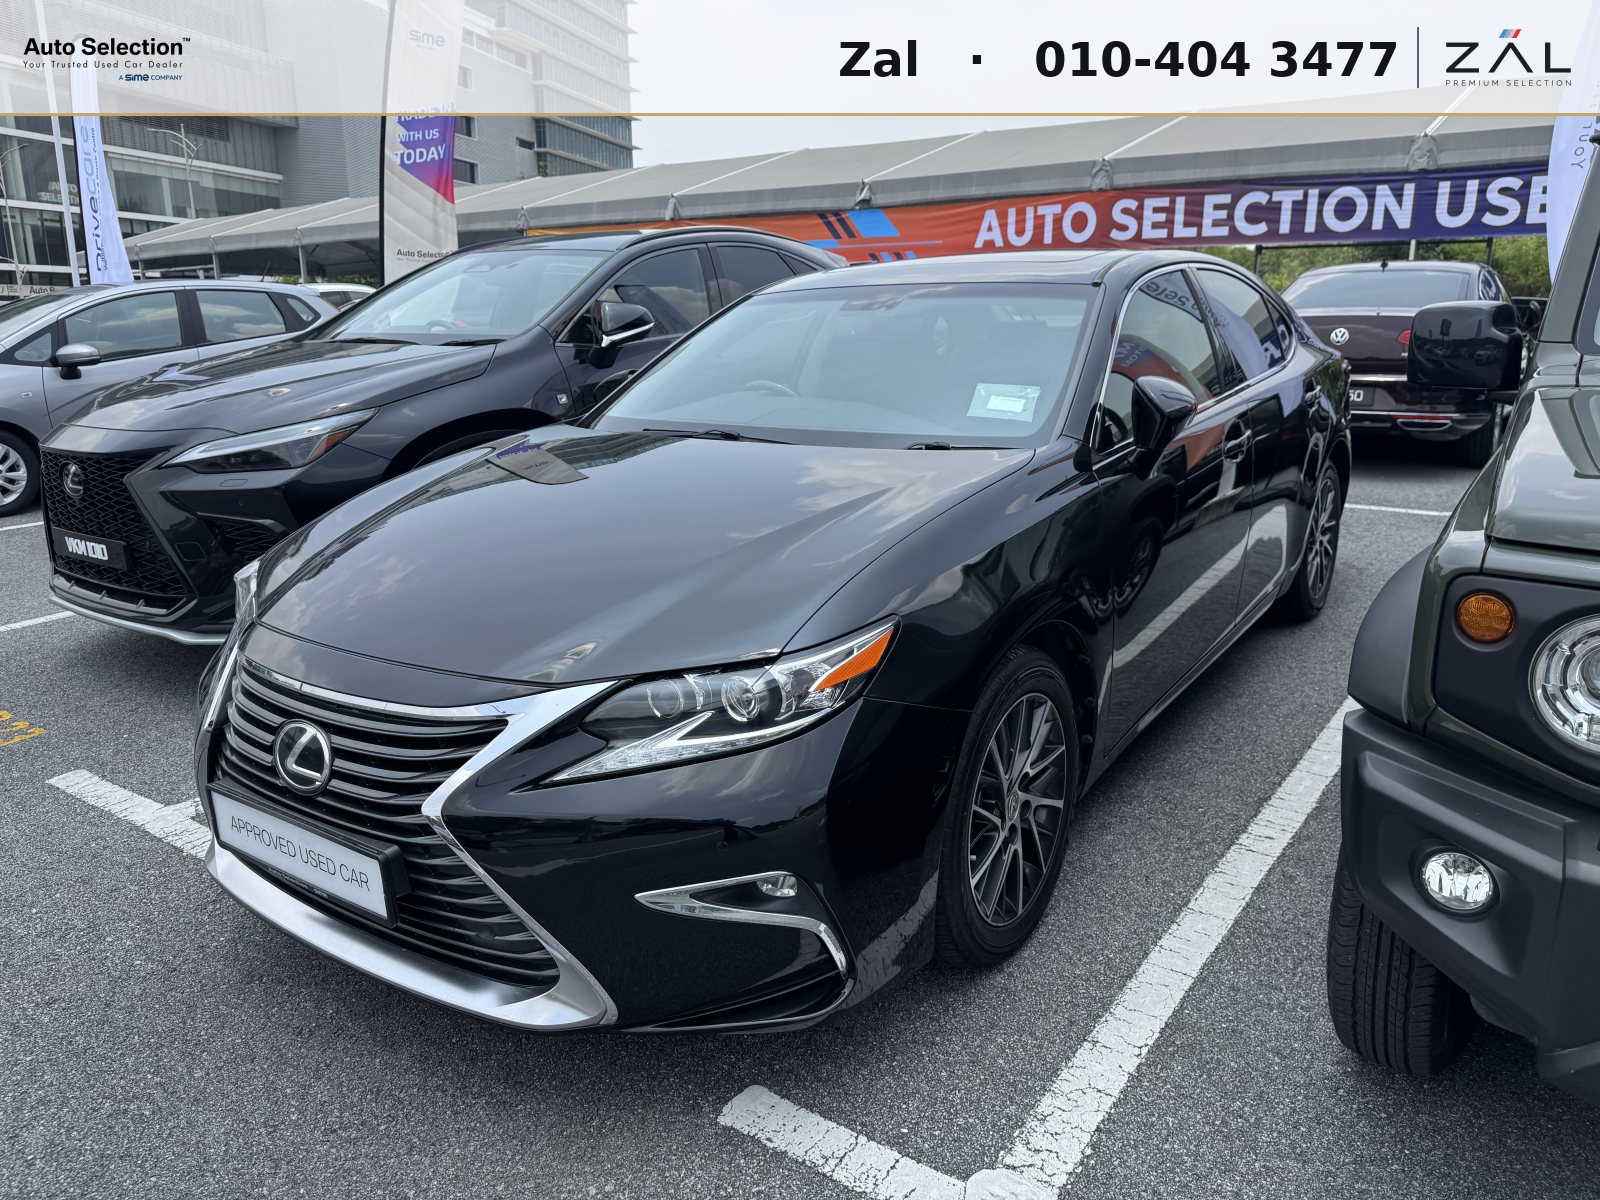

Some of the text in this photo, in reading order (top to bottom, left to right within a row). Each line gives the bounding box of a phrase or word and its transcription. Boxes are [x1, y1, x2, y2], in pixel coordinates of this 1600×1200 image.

[396, 128, 440, 142] WITH US
[394, 144, 446, 165] TODAY
[974, 201, 1097, 249] AUTO
[1109, 182, 1415, 241] SELECTION
[396, 249, 416, 257] Auto
[231, 816, 296, 858] APPROVED
[299, 844, 336, 876] USED
[339, 863, 371, 892] CAR
